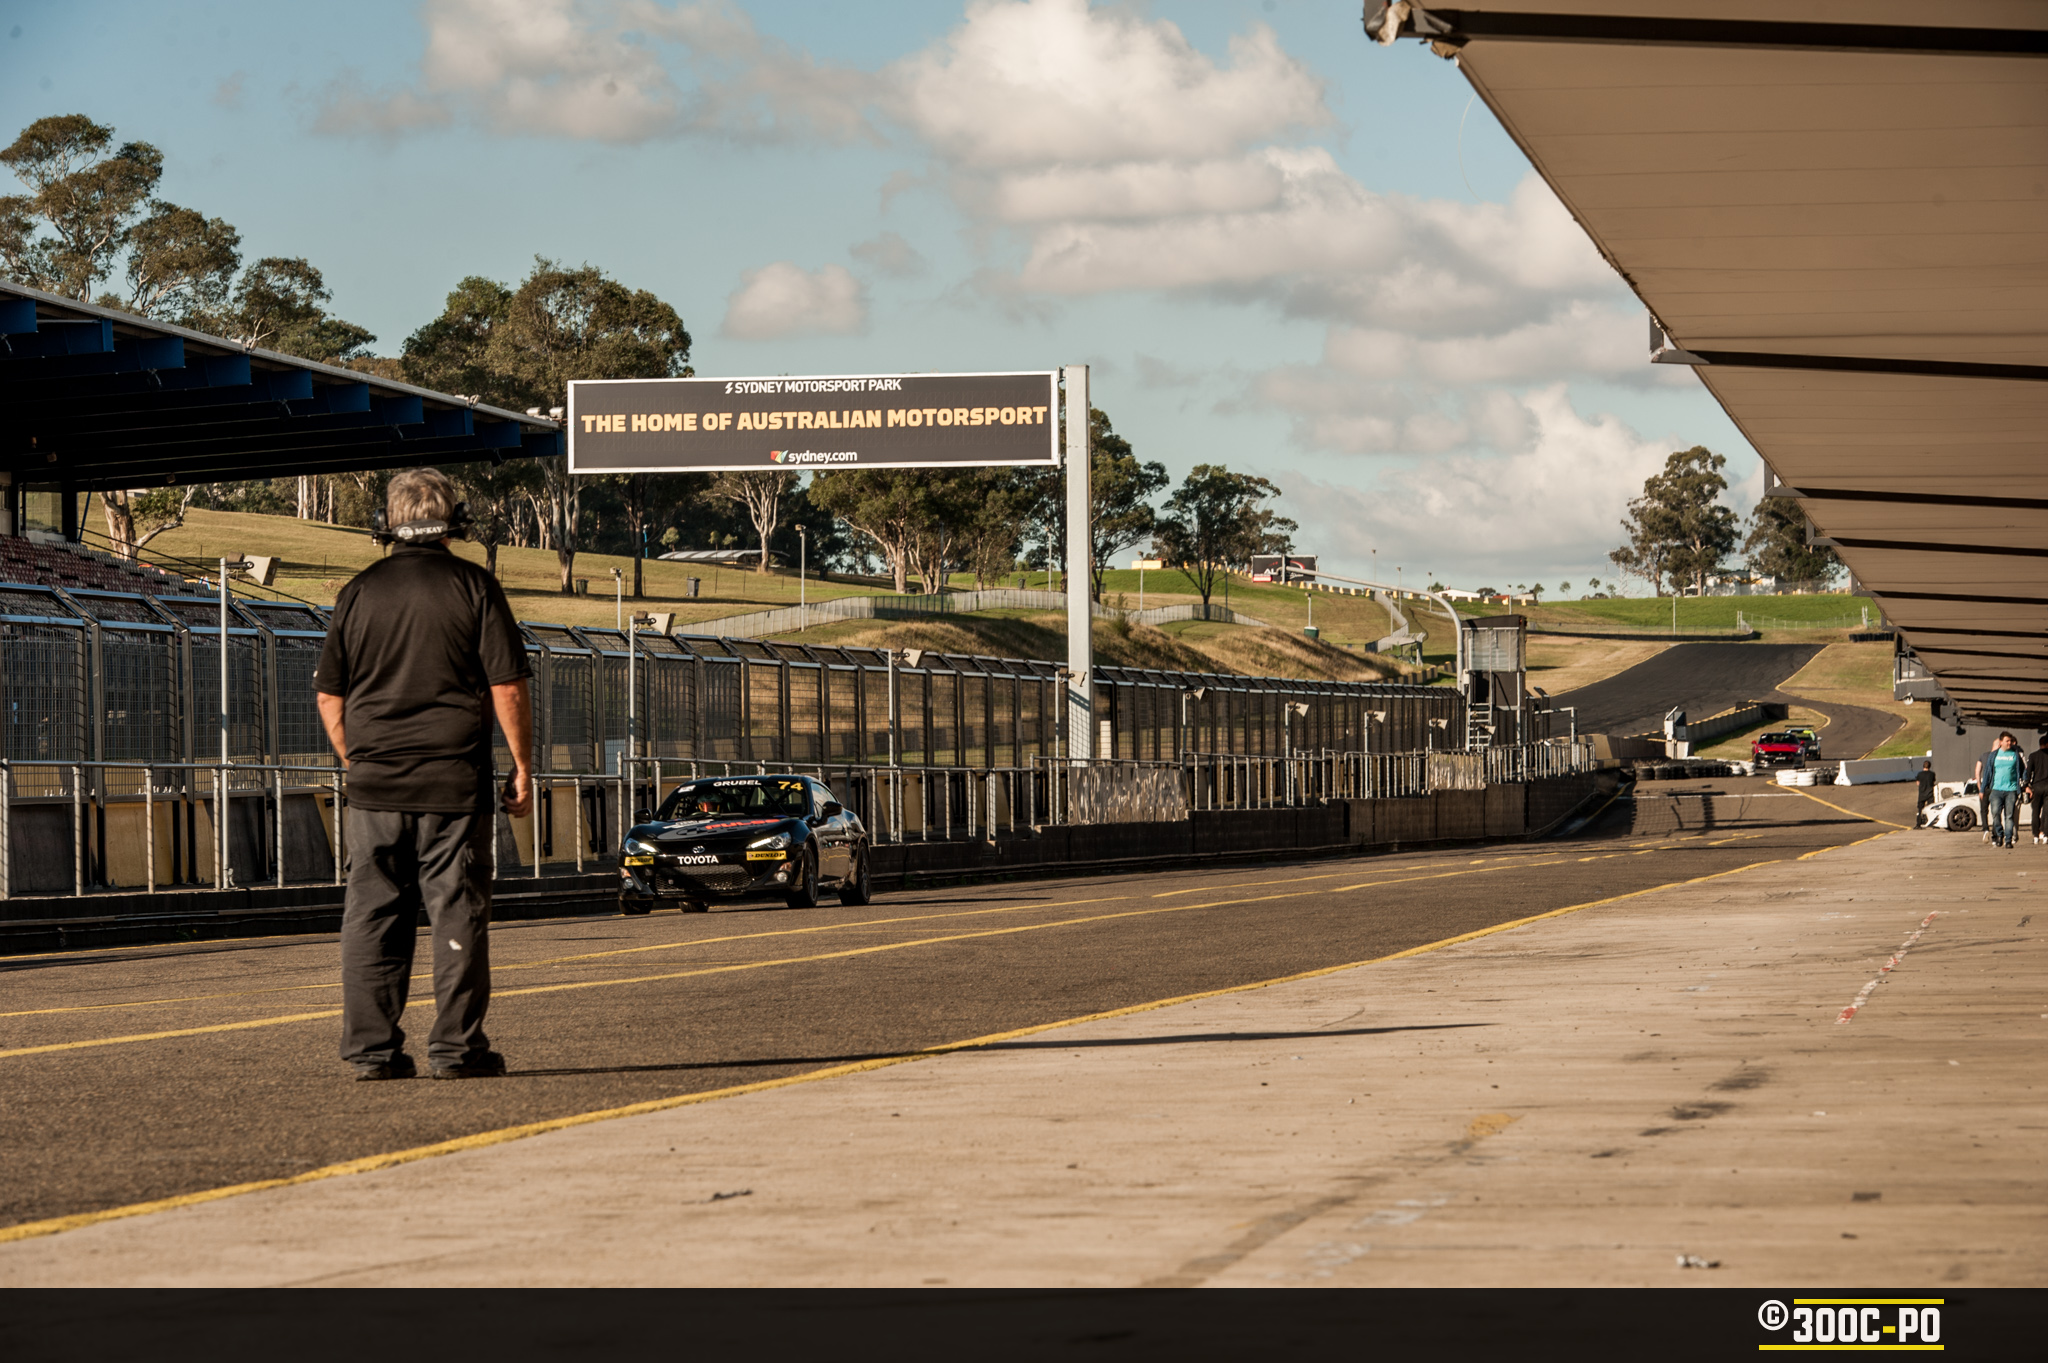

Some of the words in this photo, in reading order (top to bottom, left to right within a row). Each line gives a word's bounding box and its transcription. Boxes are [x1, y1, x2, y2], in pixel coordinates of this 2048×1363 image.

[734, 381, 783, 394] SYDNEY
[784, 379, 867, 393] MOTORSPORT
[868, 378, 902, 391] PARK
[581, 414, 626, 433] THE
[631, 412, 697, 432] HOME
[702, 412, 733, 431] OF
[736, 410, 882, 431] AUSTRALIAN
[887, 406, 1048, 428] MOTORSPORT
[788, 450, 858, 465] sydney.com
[777, 781, 803, 791] 74
[677, 855, 719, 865] TOYOTA
